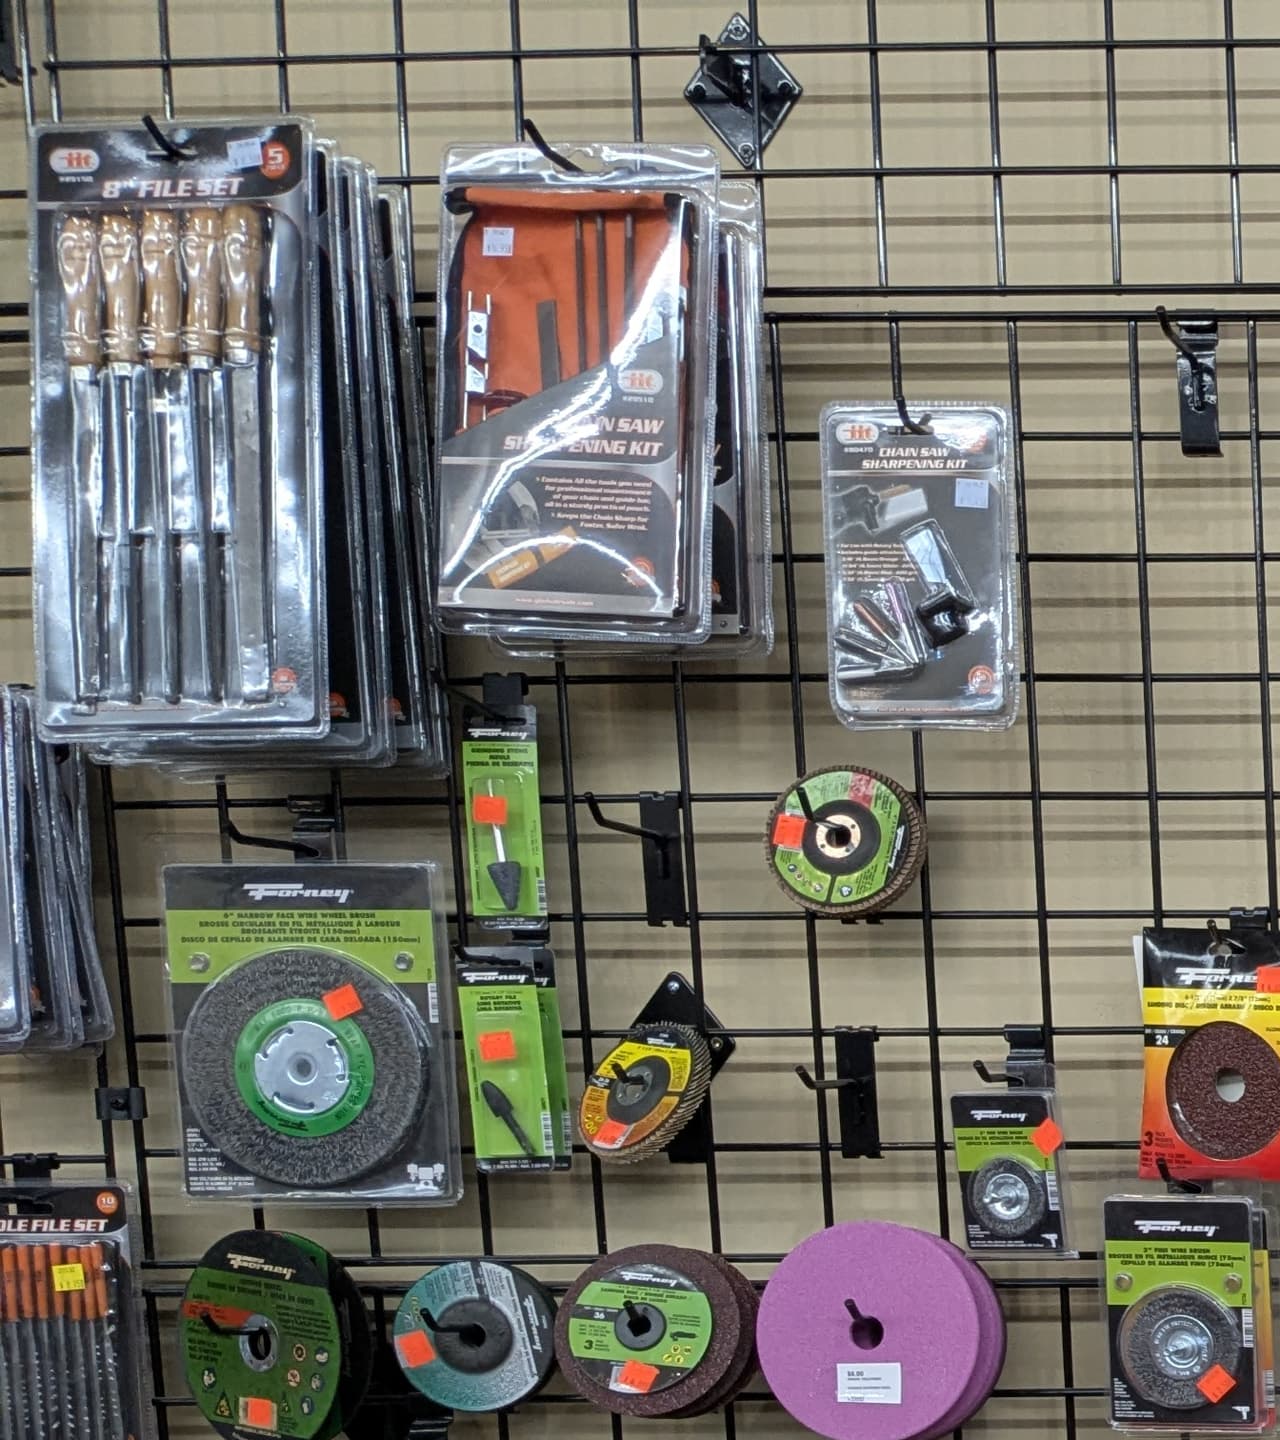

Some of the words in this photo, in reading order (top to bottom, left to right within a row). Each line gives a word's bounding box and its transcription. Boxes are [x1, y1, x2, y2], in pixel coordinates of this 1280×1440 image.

[268, 149, 284, 164] 5
[138, 180, 192, 198] FILE
[196, 177, 244, 195] SET
[616, 417, 664, 434] SAW
[629, 440, 664, 457] KIT
[878, 447, 918, 457] CHAIN
[919, 447, 950, 458] SAW
[862, 459, 945, 470] SHARPENING
[947, 459, 968, 470] KIT
[468, 728, 528, 740] Forney
[243, 883, 350, 903] Forney
[1156, 1035, 1169, 1046] 24
[970, 1110, 1027, 1121] Forney
[100, 1197, 115, 1207] 10
[32, 1219, 72, 1232] FILE
[75, 1219, 108, 1231] SET
[1134, 1220, 1219, 1237] Forney
